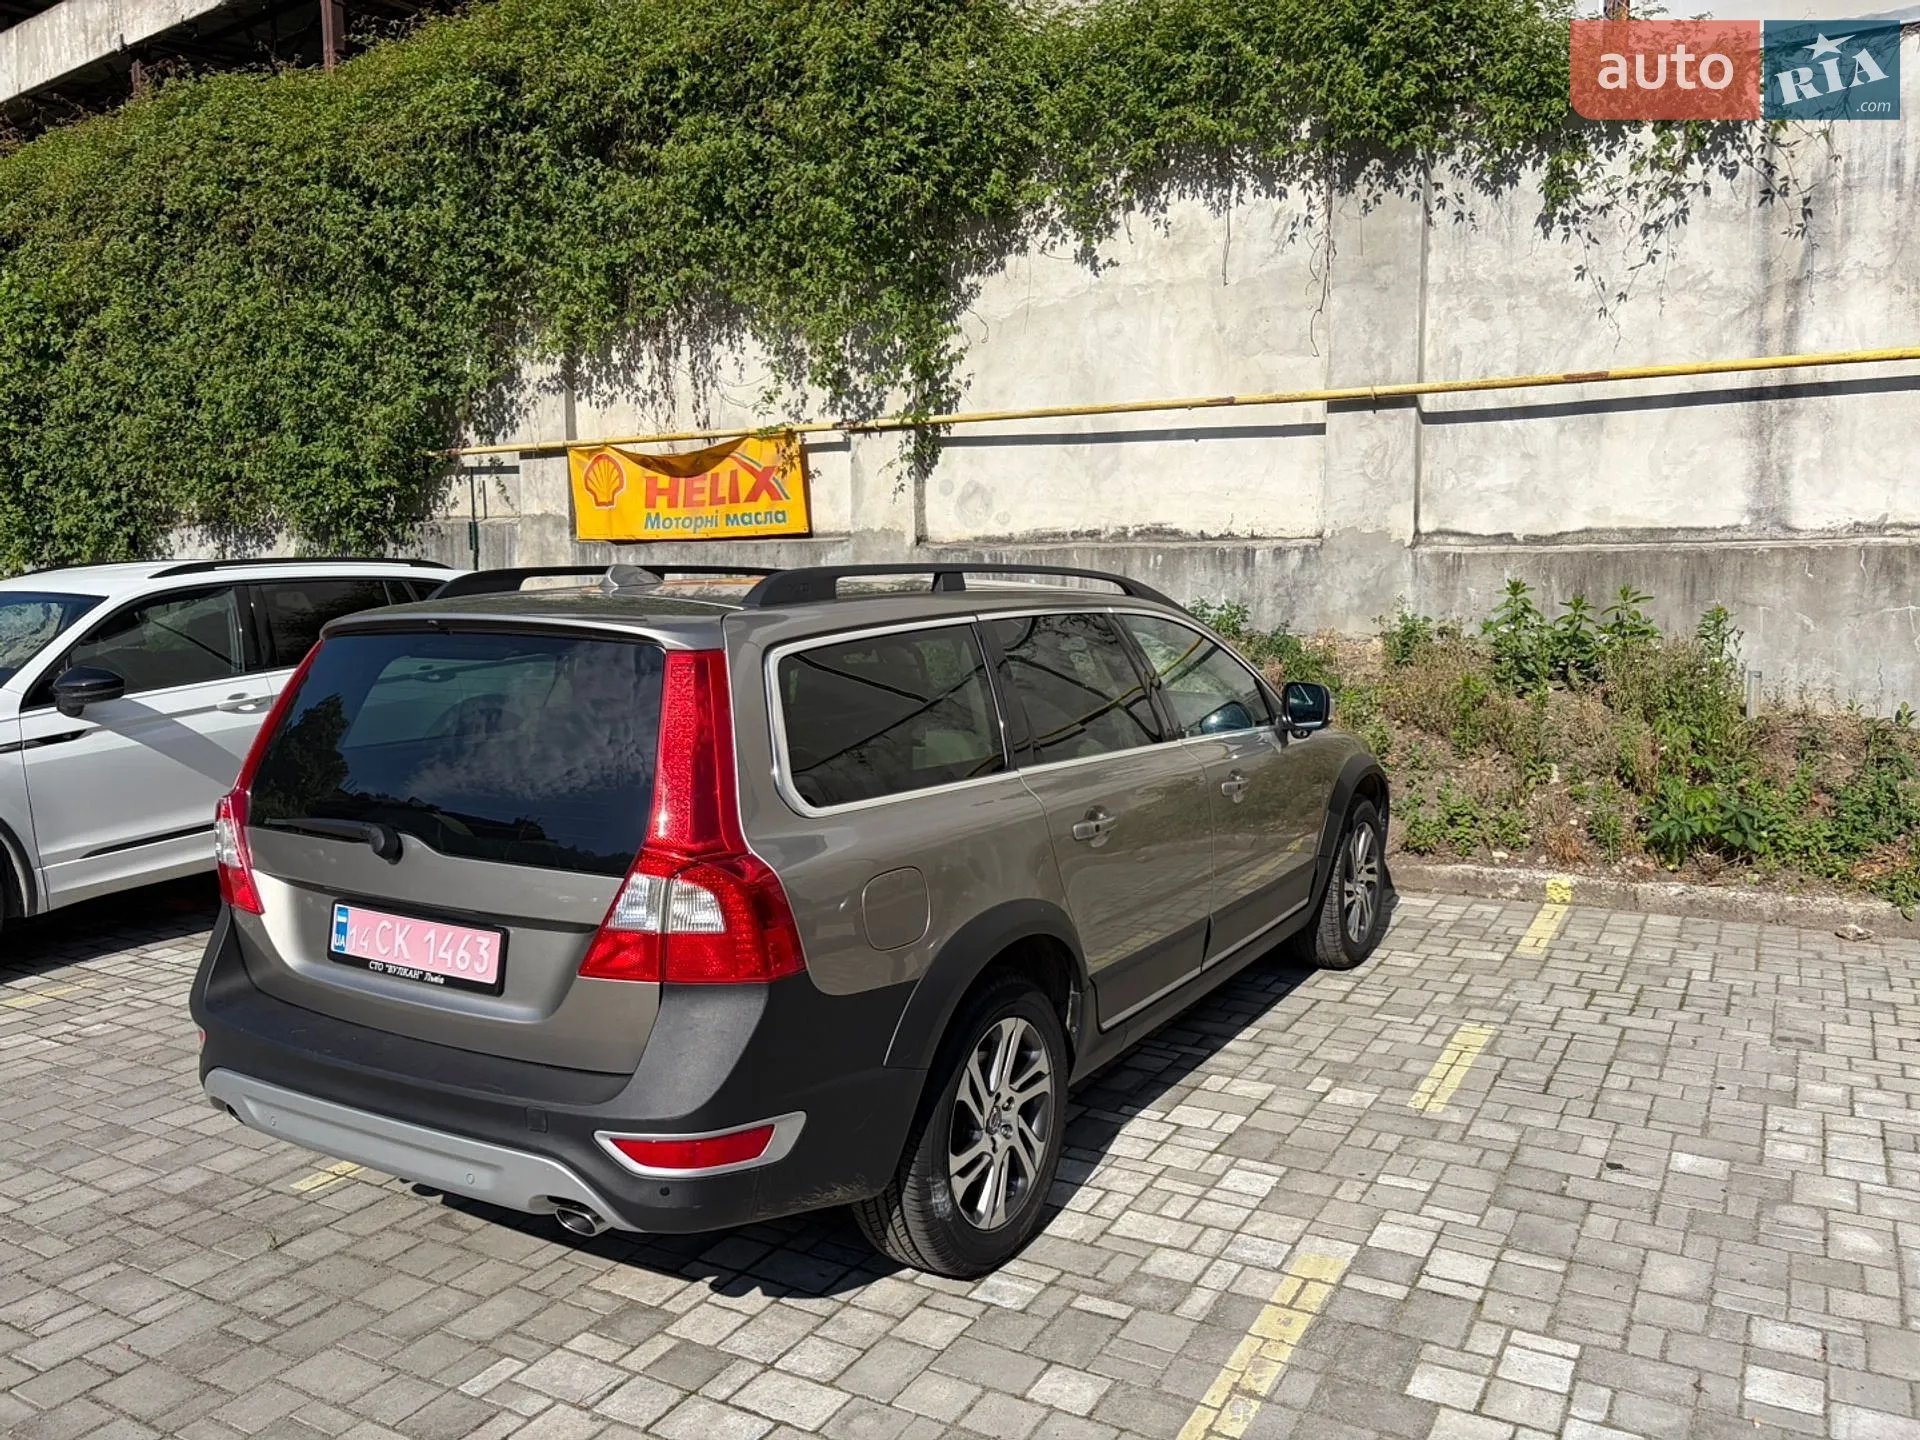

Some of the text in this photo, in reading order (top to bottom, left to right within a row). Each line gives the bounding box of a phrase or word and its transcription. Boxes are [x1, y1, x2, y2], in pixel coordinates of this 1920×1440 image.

[645, 462, 786, 509] HELIX
[644, 510, 788, 533] Моторні масла
[335, 933, 346, 947] UA
[423, 928, 493, 975] 1463
